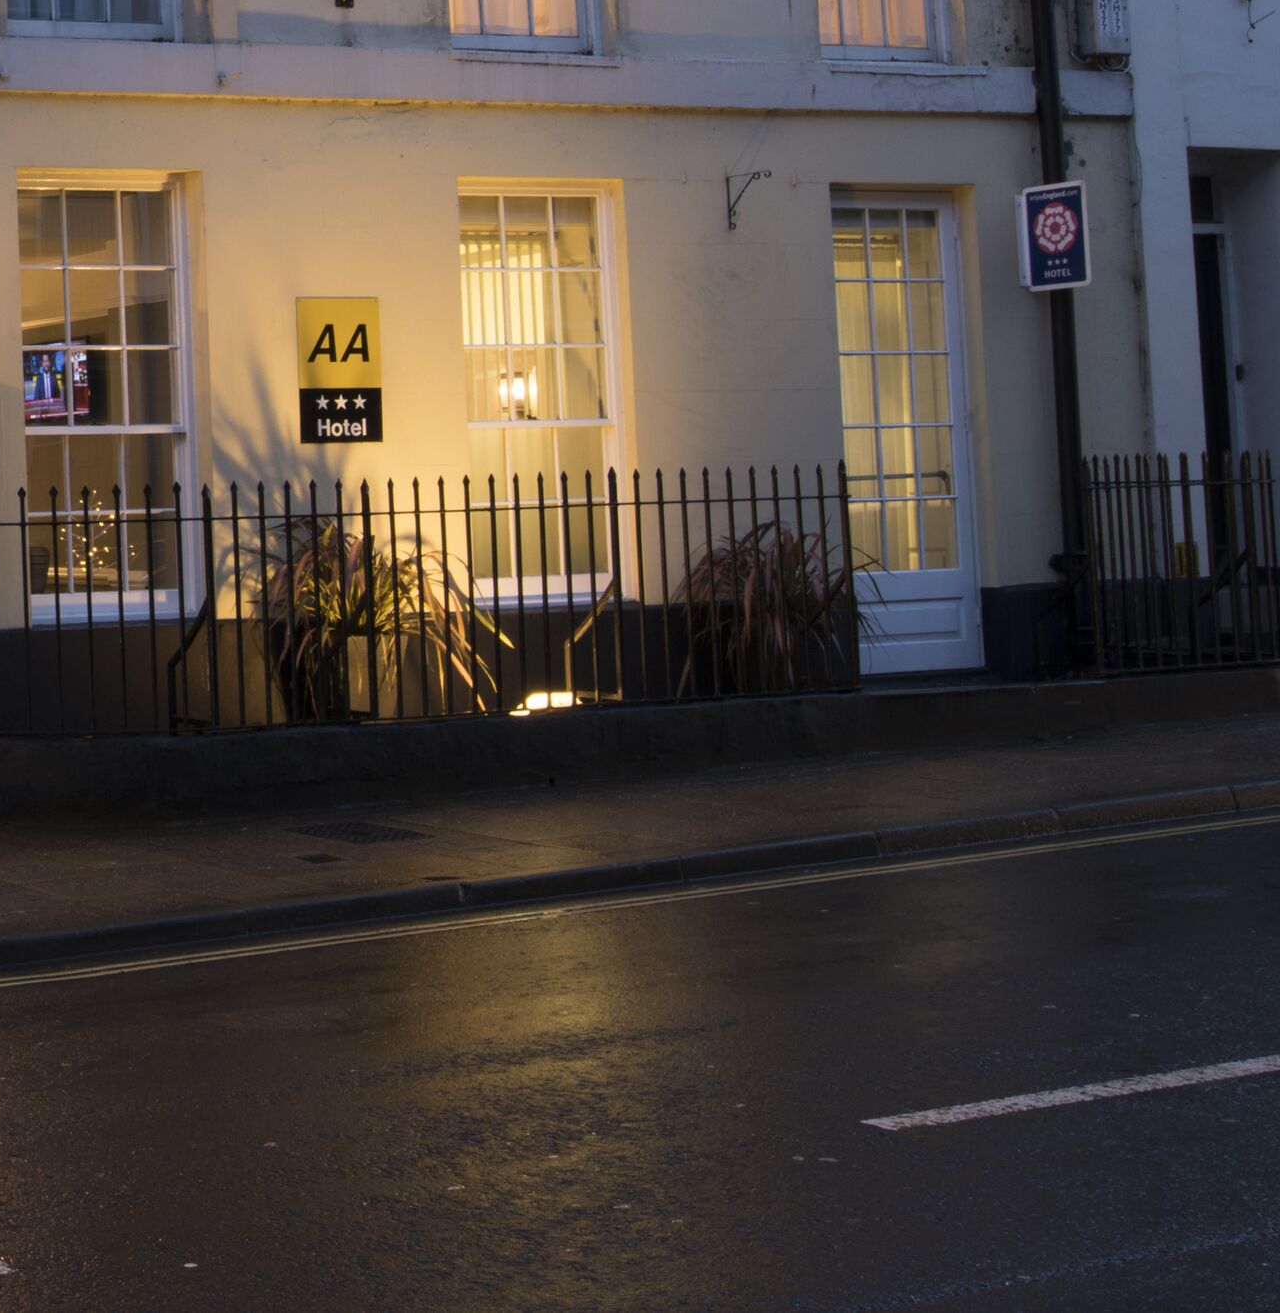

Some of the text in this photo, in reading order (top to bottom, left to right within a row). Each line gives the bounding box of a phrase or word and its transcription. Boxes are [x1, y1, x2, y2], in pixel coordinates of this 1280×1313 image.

[1044, 268, 1072, 278] HOTEL
[307, 323, 370, 363] AA
[317, 418, 367, 437] Hotel
